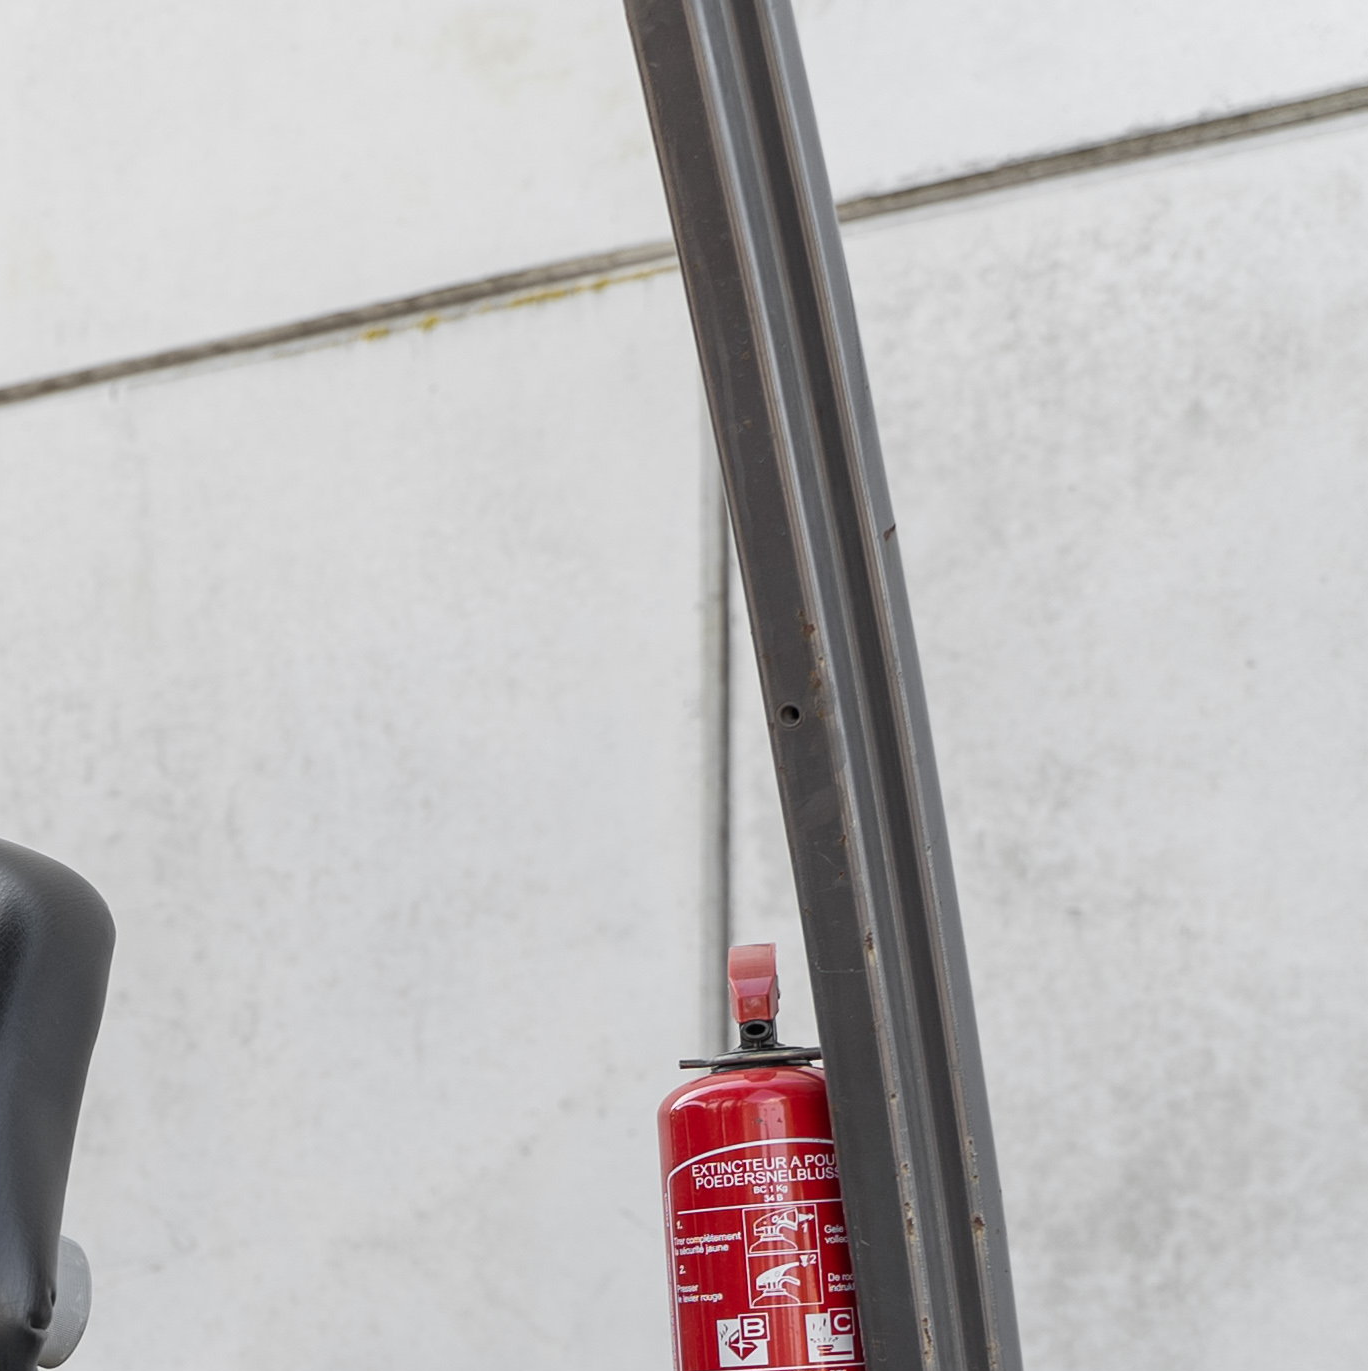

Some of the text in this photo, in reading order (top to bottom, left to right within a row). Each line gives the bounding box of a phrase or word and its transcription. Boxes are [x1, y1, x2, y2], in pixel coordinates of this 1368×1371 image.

[691, 1156, 788, 1178] EXTINCTEUR
[790, 1156, 803, 1168] A
[769, 1184, 774, 1194] 1
[775, 1183, 789, 1194] Kg
[742, 1317, 765, 1335] B
[833, 1313, 851, 1332] C
